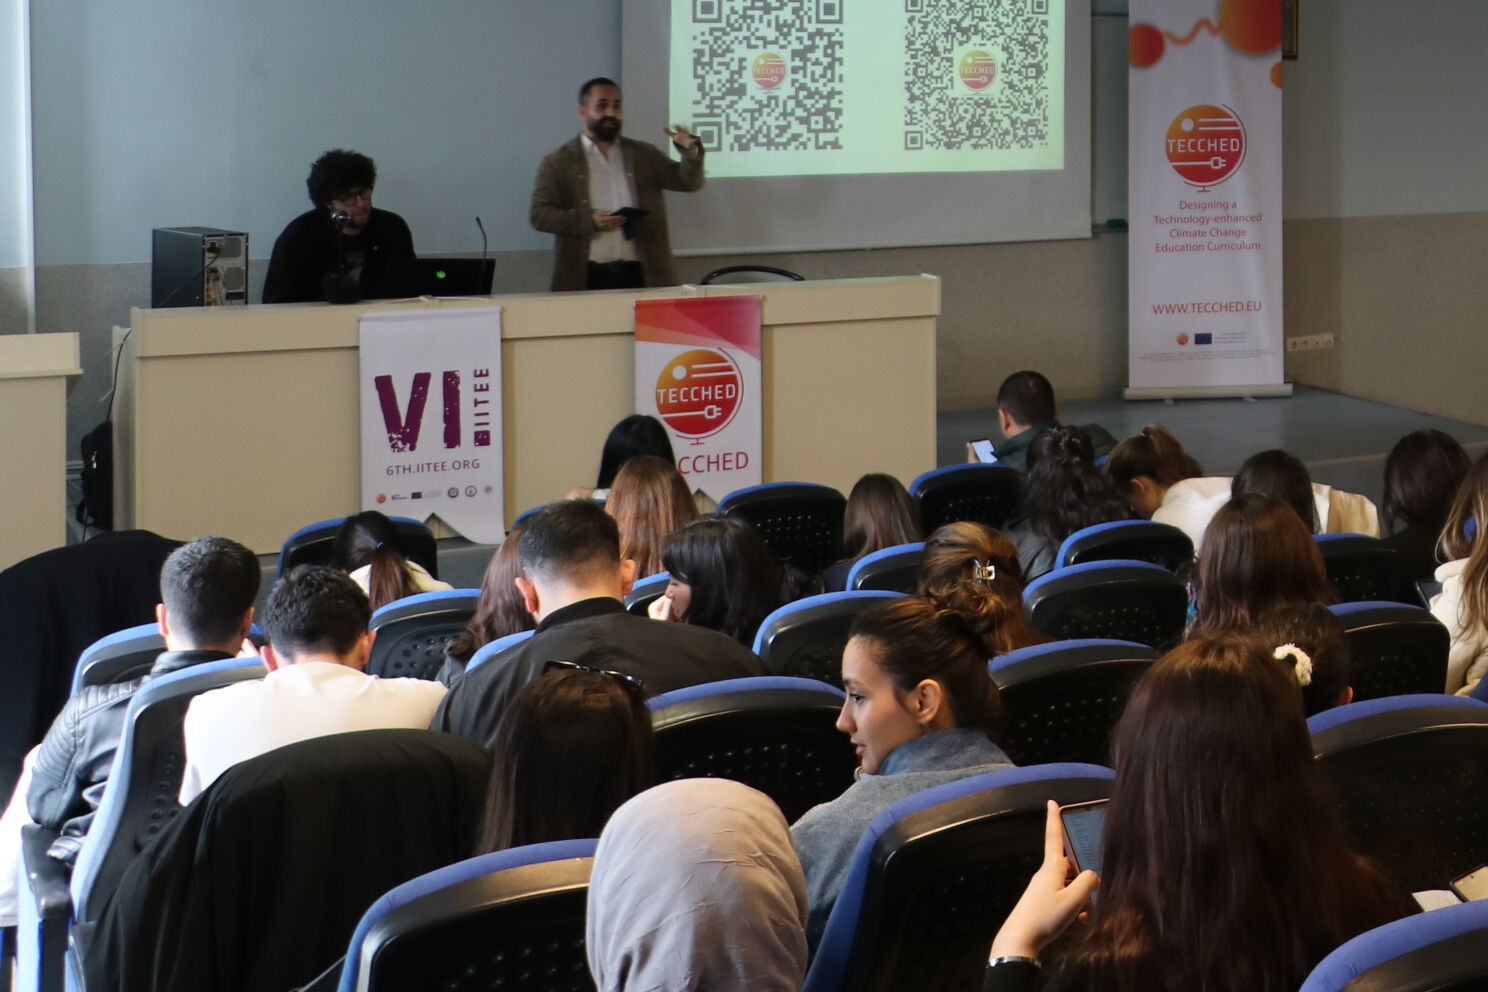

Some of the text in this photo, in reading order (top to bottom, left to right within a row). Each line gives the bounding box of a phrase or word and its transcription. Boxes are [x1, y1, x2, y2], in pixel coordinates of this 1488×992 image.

[1167, 138, 1240, 153] TECCHED
[1179, 200, 1229, 211] Designing
[1153, 213, 1263, 225] Technology-enhanced
[1170, 228, 1247, 238] Climate Change
[1155, 241, 1262, 252] Education Curriculum
[1153, 301, 1262, 314] WWW.TECCHED.EU
[473, 369, 490, 427] IITEE
[657, 383, 736, 404] TECCHED
[386, 459, 480, 475] 6TH.IITEE.ORG
[678, 451, 749, 475] CCHED
